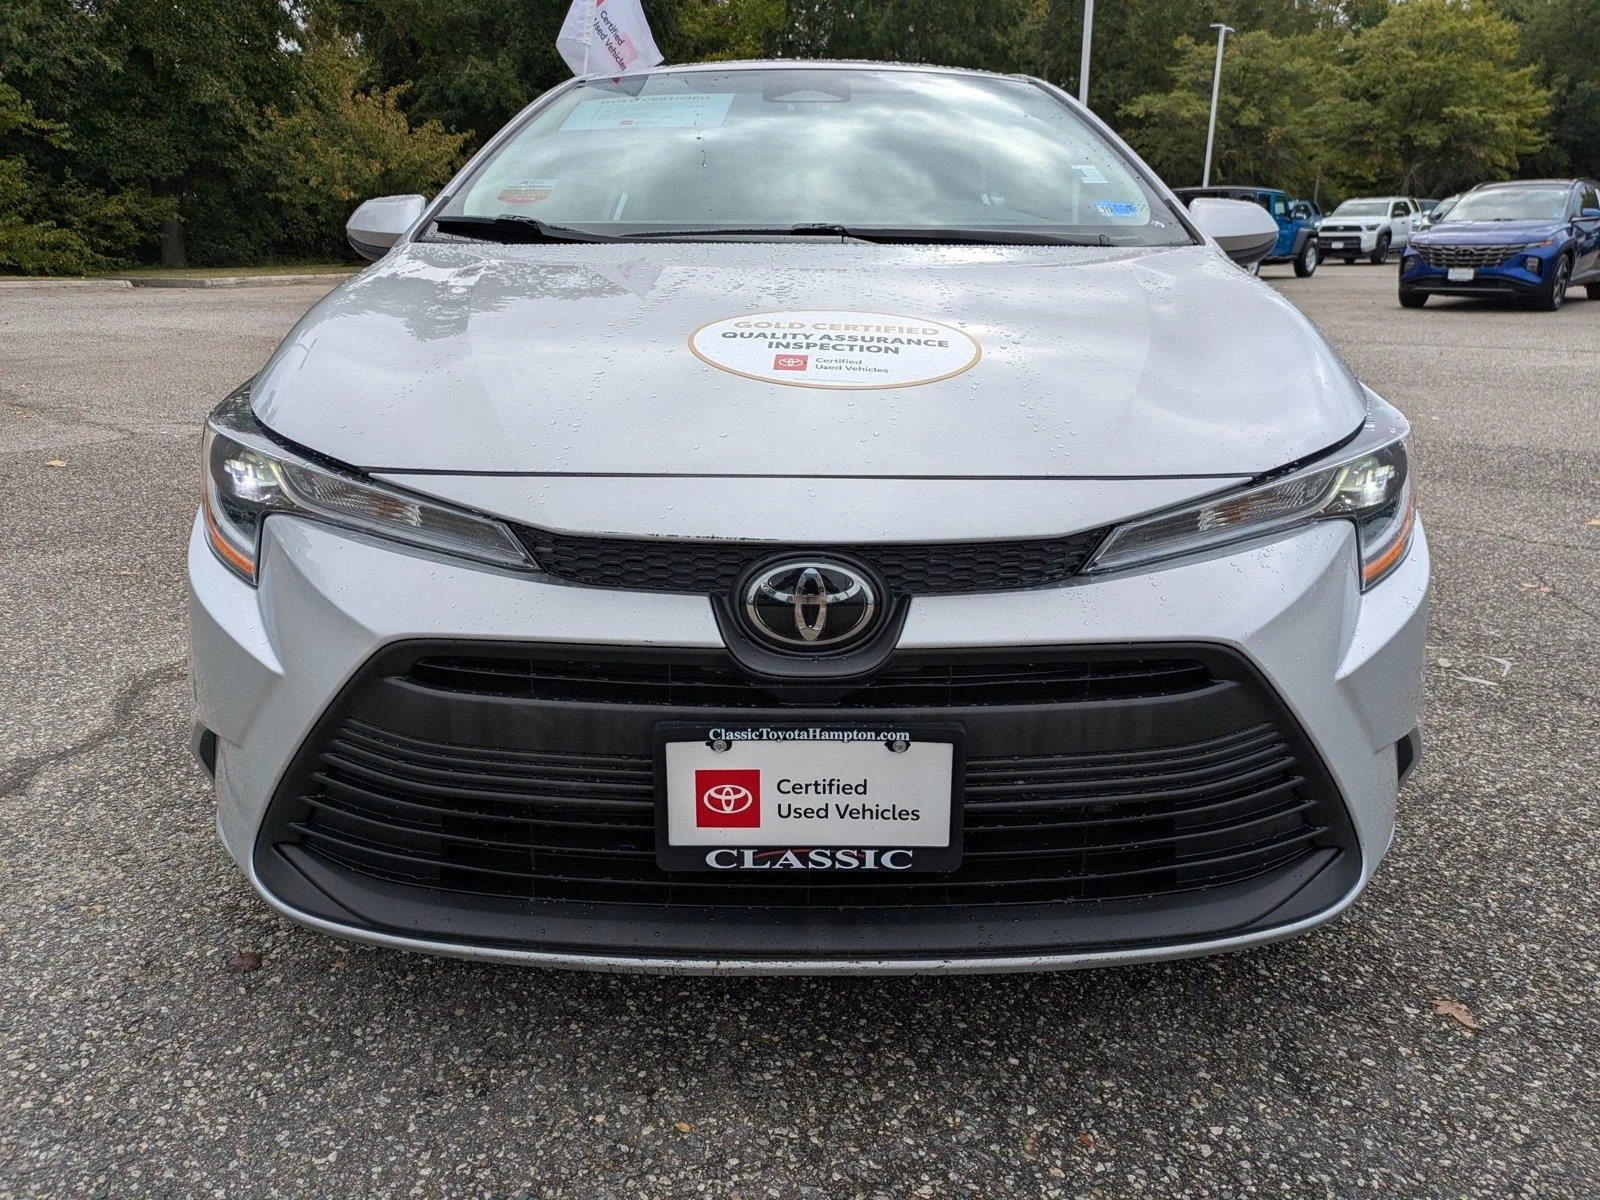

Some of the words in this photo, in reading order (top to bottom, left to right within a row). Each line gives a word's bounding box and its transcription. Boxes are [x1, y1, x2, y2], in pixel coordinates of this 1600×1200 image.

[600, 10, 625, 46] Certified
[605, 38, 627, 71] Vehicles
[734, 321, 805, 330] GOLD
[811, 323, 940, 336] CERTIFIED
[721, 331, 814, 340] QUALITY
[818, 334, 949, 348] ASSURANCE
[767, 341, 900, 355] INSPECTION
[815, 357, 863, 366] Certified
[815, 364, 844, 372] Used
[847, 365, 889, 374] Vehicles
[708, 728, 910, 742] ClassicToyotaHampton.com
[776, 778, 868, 796] Certified
[776, 803, 829, 820] Used
[835, 804, 920, 821] Vehicles
[705, 849, 913, 869] CLASSIC
